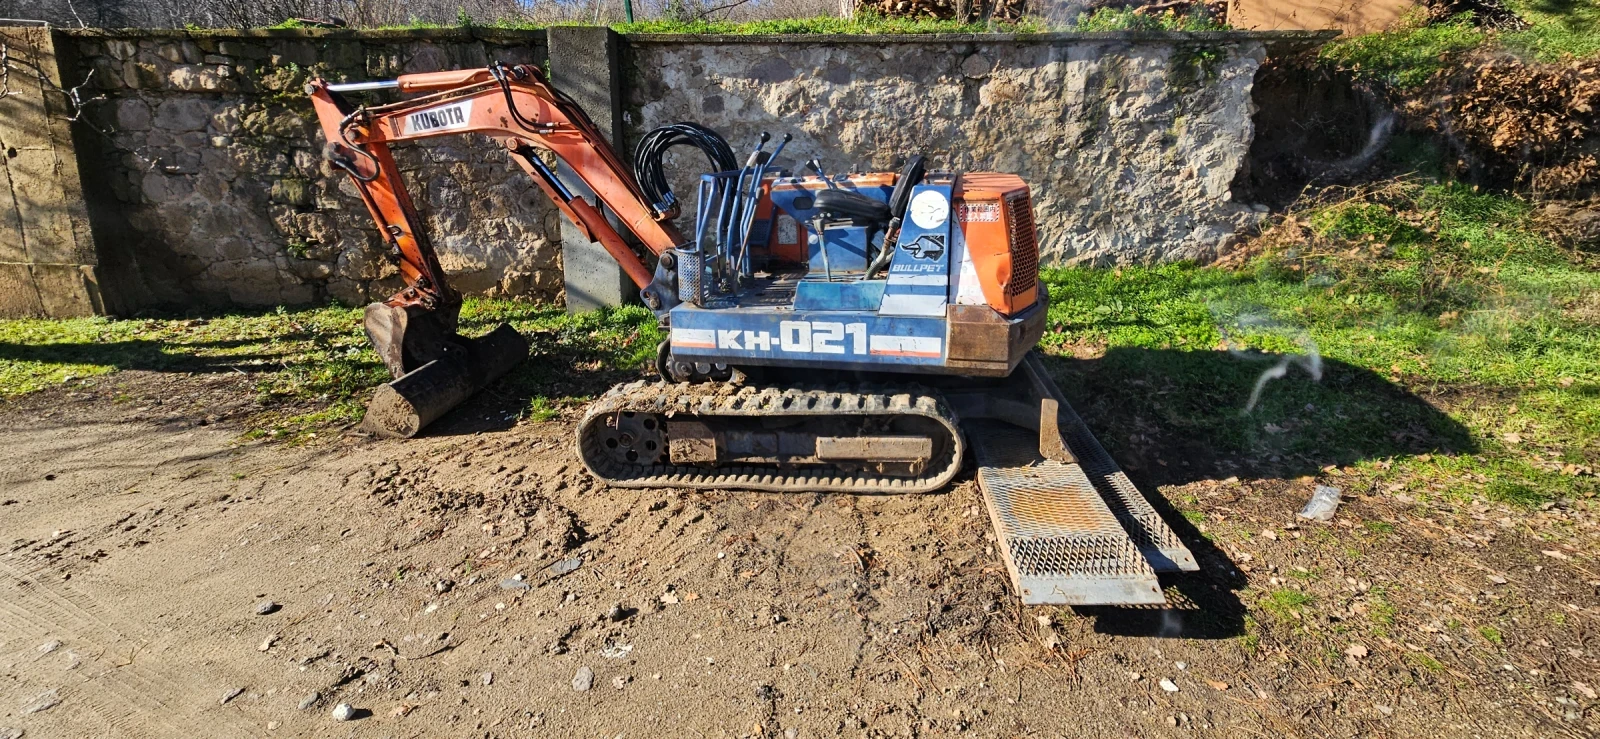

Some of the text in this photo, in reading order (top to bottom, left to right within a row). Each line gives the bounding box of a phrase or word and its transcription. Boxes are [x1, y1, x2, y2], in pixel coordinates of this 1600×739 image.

[411, 106, 465, 132] KUBOTA
[892, 264, 945, 272] BULLPET
[717, 320, 867, 354] KH-021
